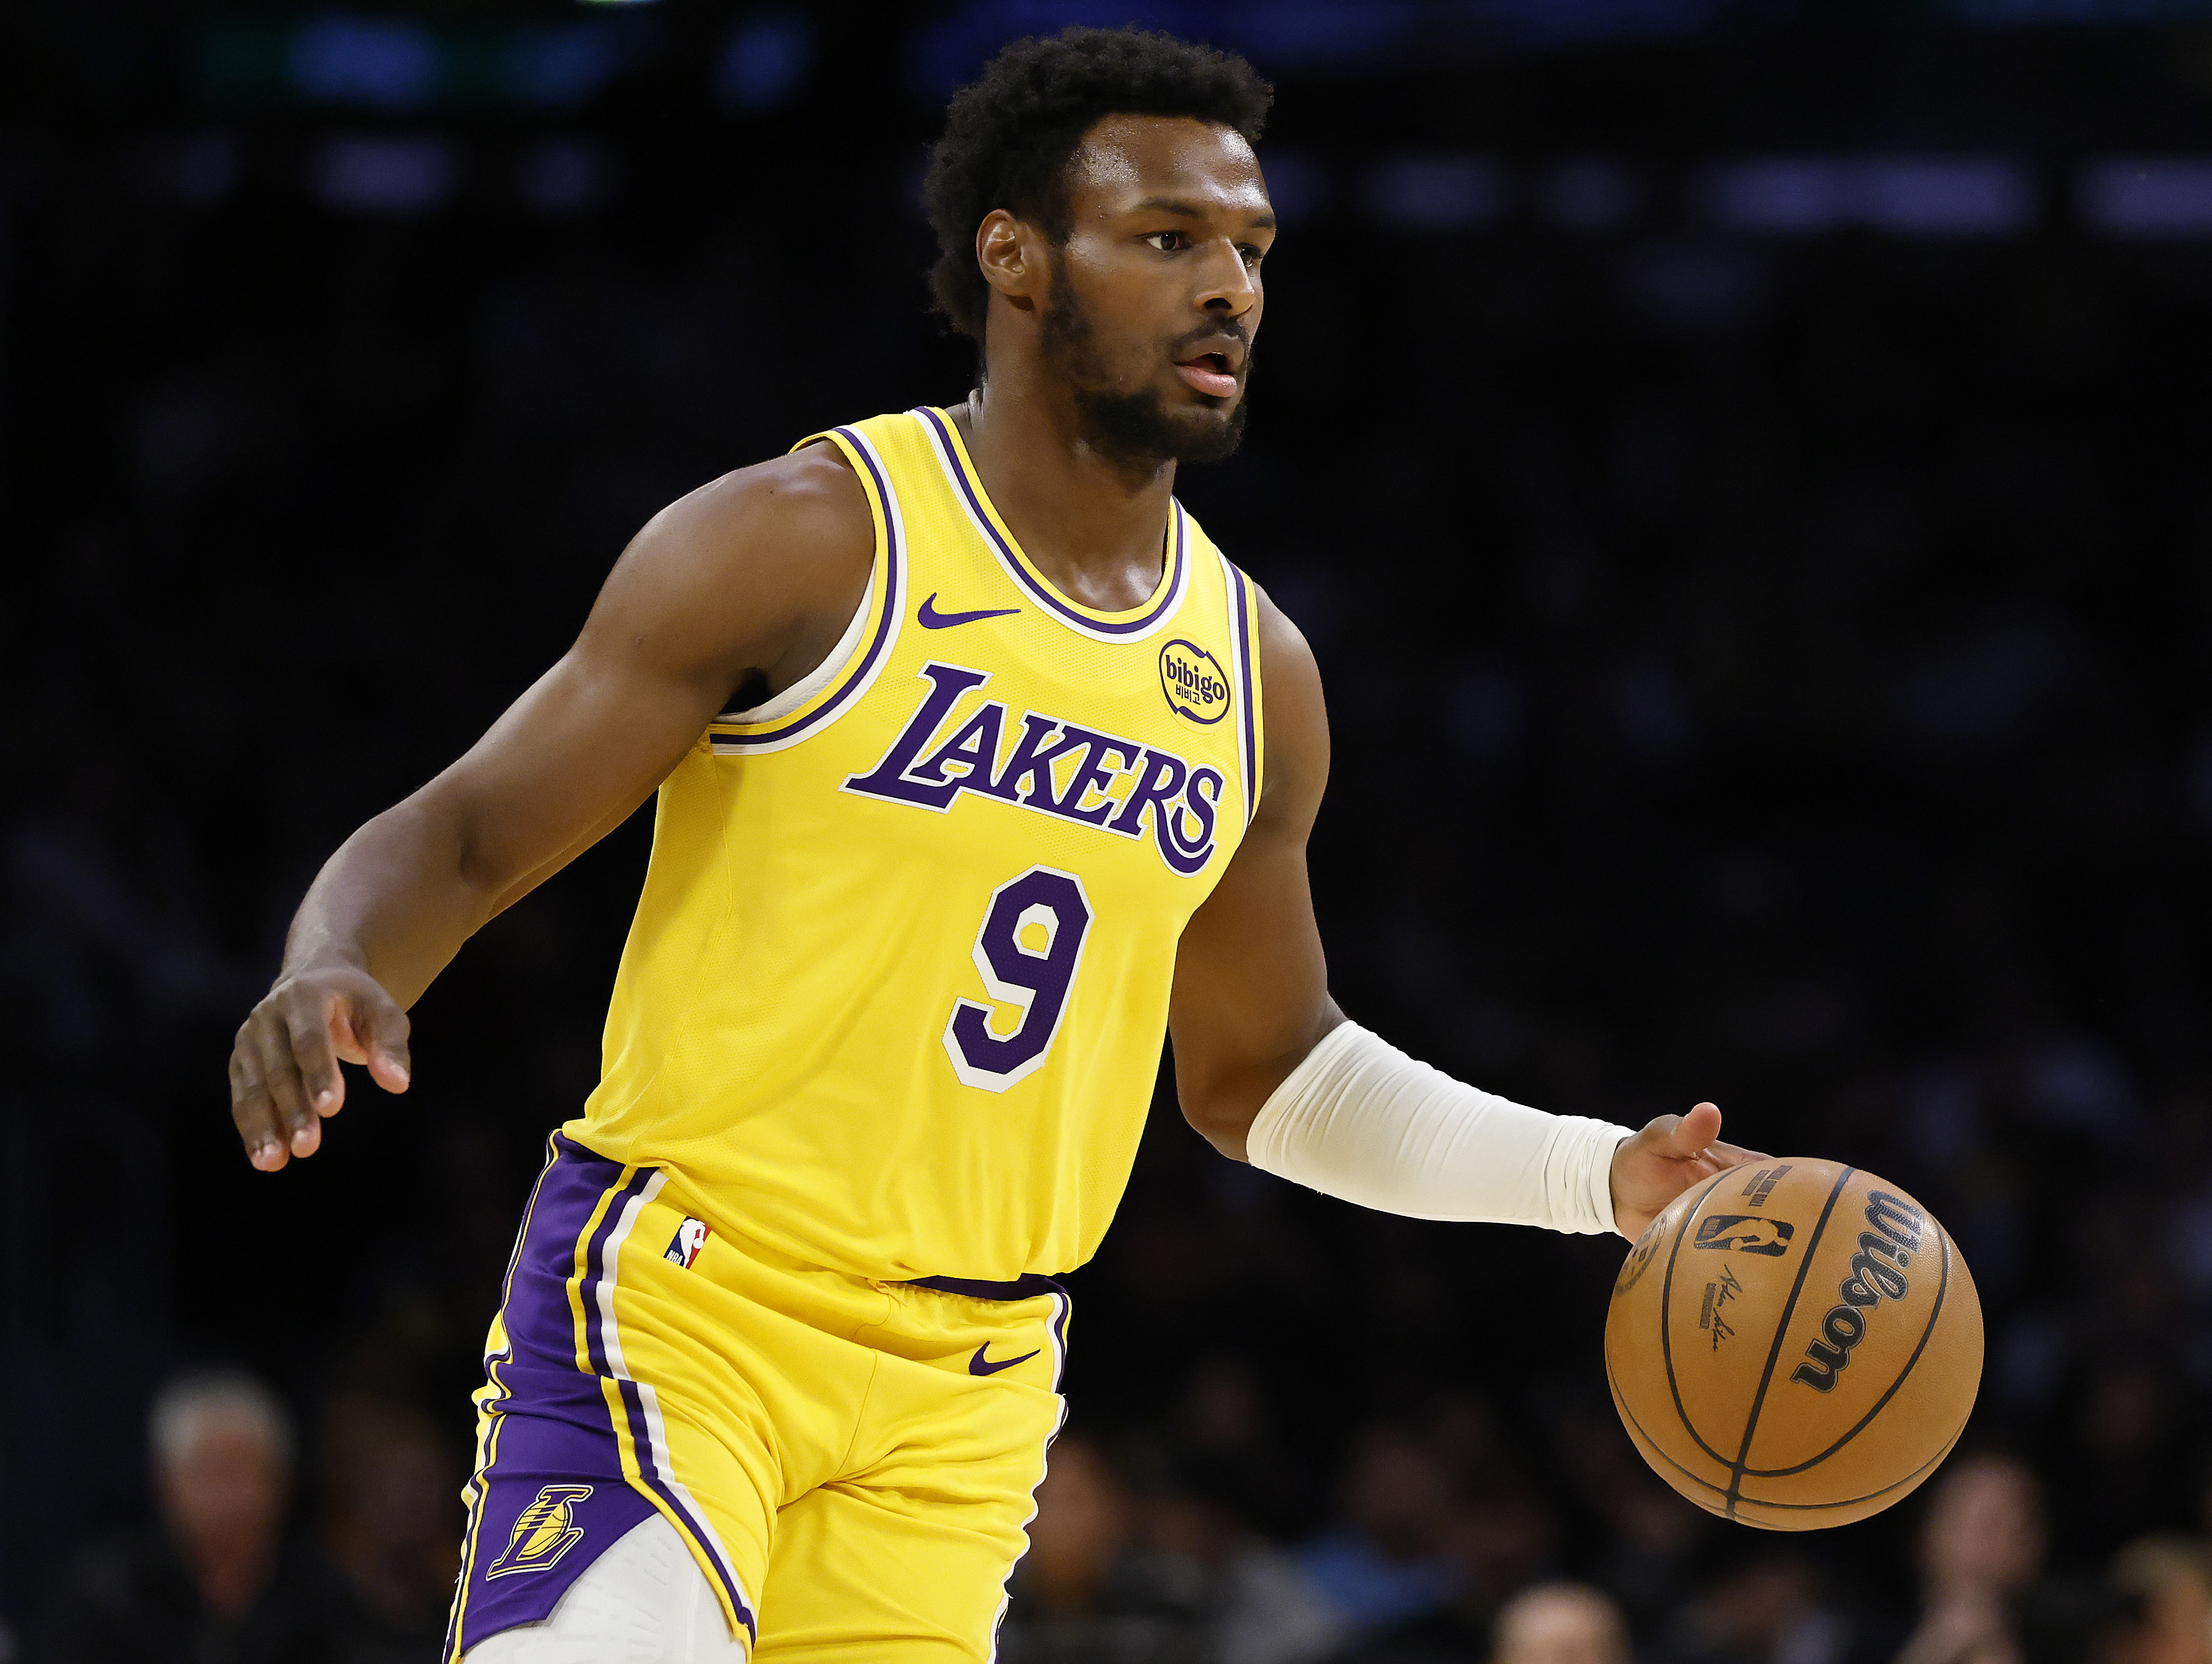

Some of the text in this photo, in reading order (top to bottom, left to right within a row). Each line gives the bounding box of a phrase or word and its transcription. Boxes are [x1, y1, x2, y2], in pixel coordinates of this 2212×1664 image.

[1165, 654, 1225, 704] bibigo
[1176, 684, 1201, 705] 비비고
[838, 659, 1227, 878] LAKERS
[942, 863, 1095, 1093] 9
[666, 1250, 683, 1265] NBA
[1789, 1189, 1923, 1393] Wilson
